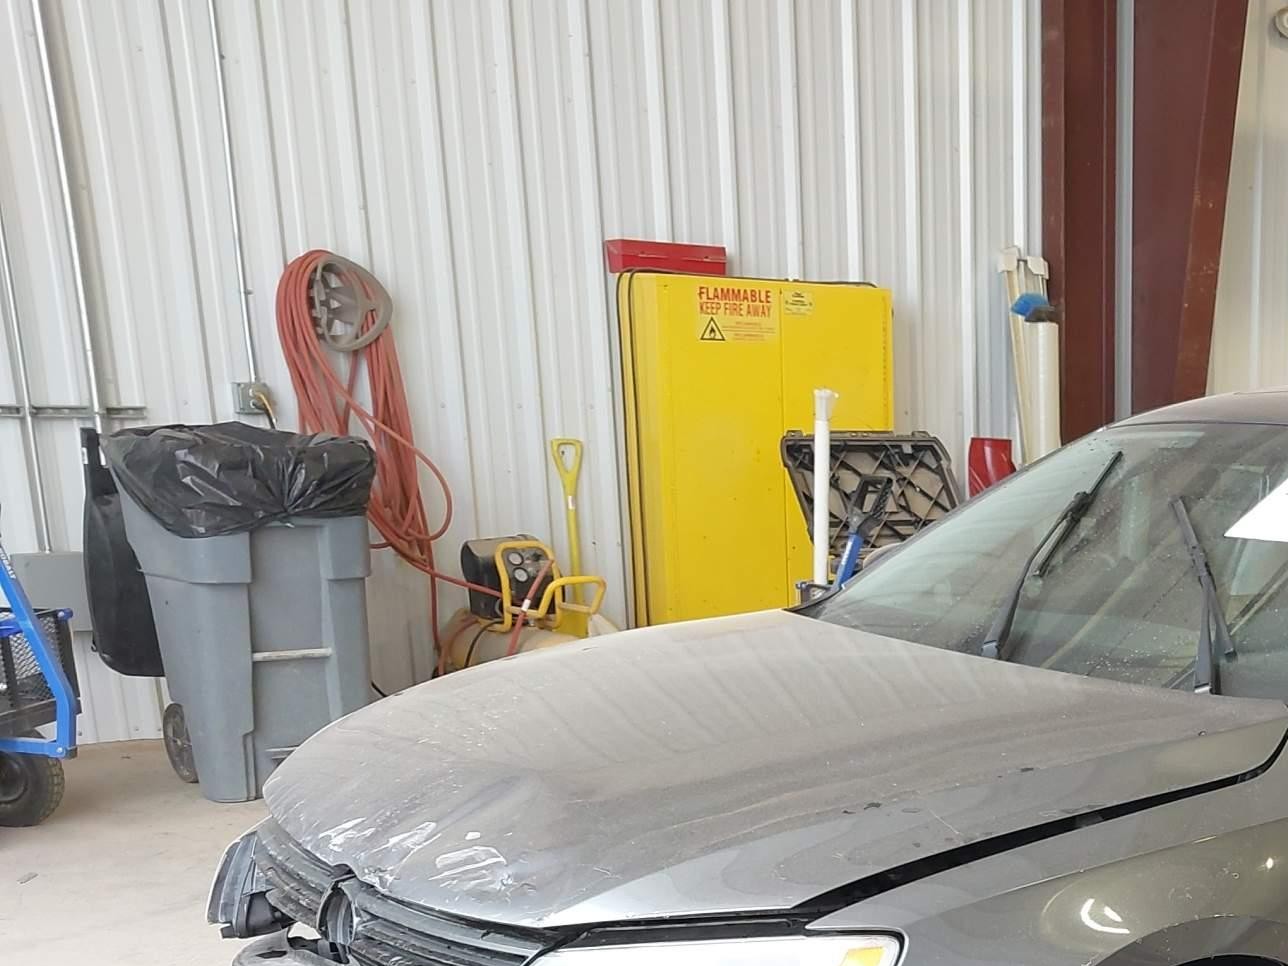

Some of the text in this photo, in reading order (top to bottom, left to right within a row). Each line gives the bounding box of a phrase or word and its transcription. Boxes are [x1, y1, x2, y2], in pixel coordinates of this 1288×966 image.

[698, 286, 772, 303] FLAMMABLE
[699, 301, 721, 316] KEEP
[723, 302, 744, 317] FIRE
[746, 303, 771, 318] AWAY
